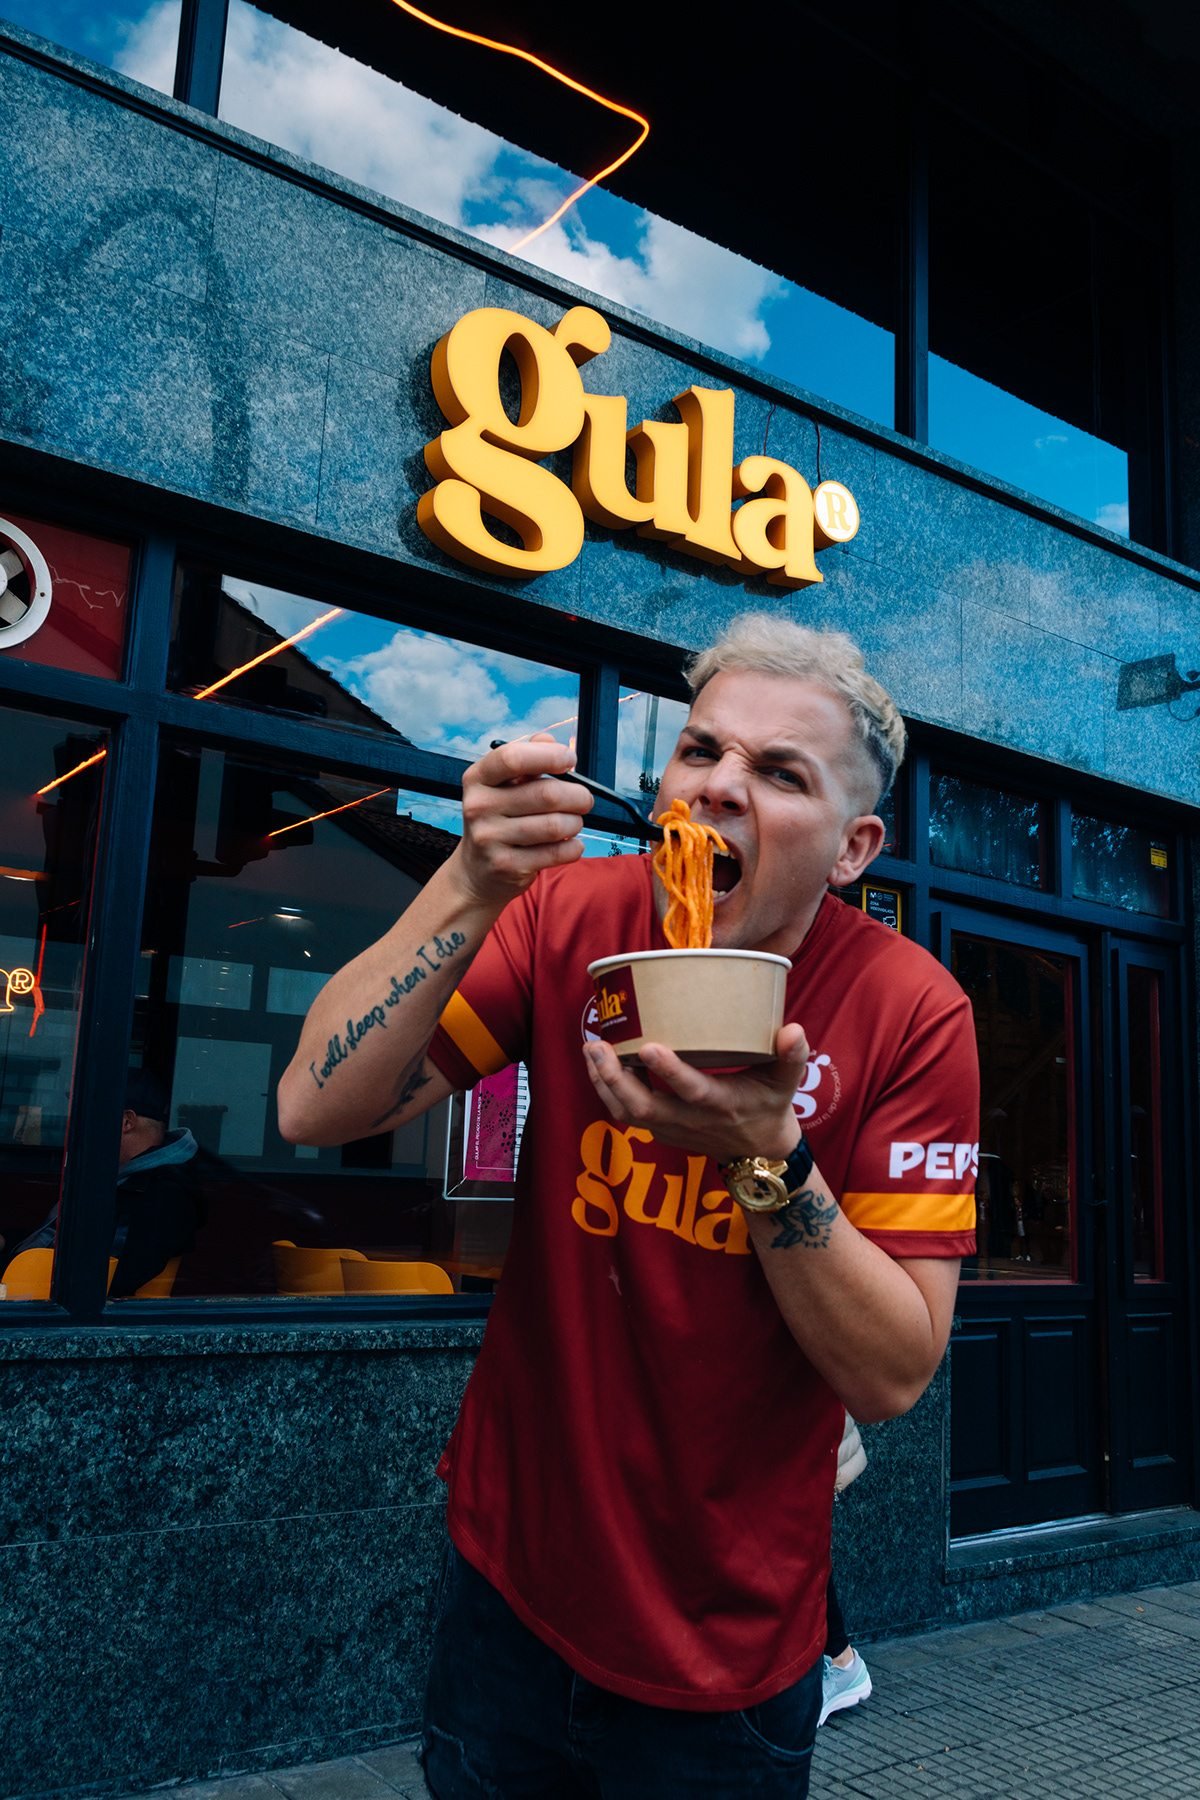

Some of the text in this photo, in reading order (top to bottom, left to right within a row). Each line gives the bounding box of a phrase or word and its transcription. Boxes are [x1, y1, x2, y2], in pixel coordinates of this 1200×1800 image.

[309, 931, 466, 1089] I will sleep when I die
